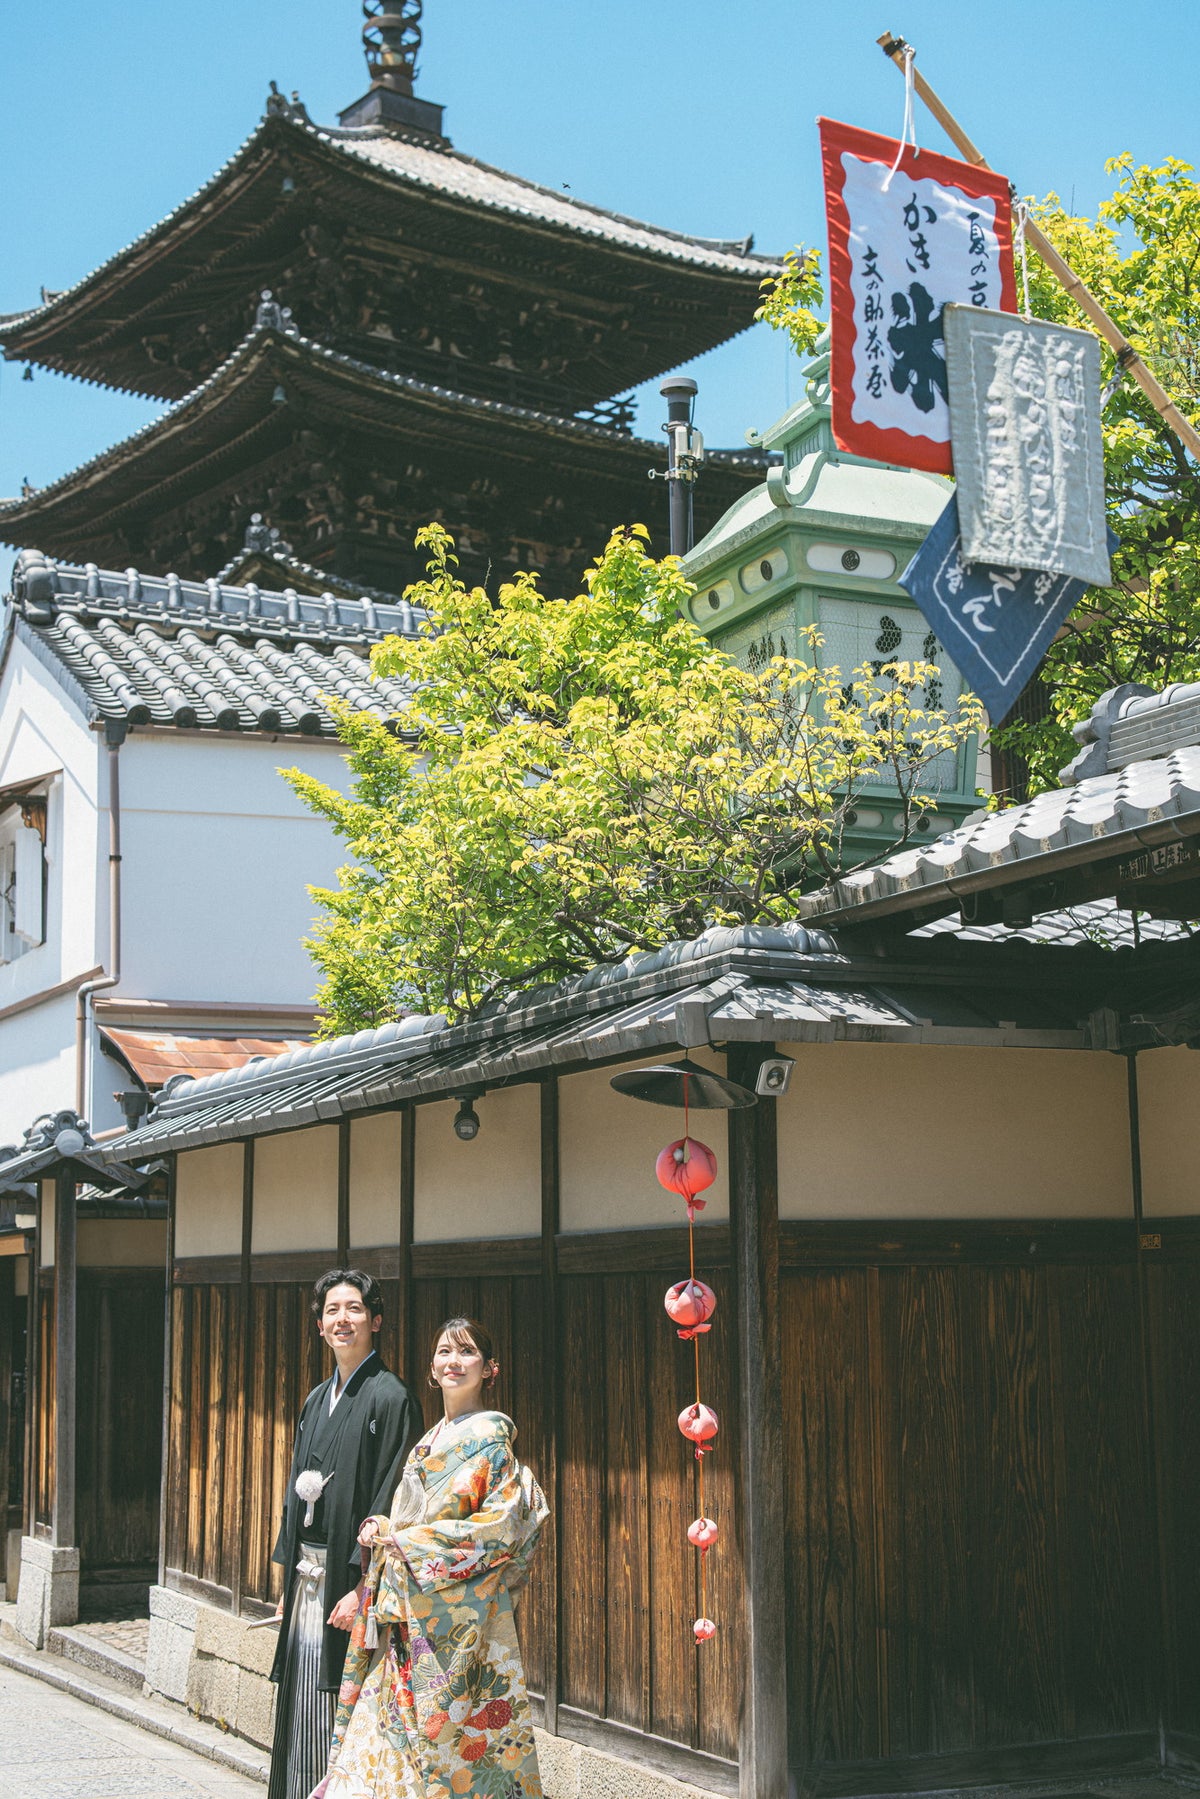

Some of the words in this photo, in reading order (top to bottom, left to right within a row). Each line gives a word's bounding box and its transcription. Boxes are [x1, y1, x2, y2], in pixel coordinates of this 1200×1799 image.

[860, 244, 888, 399] 文の助茶屋
